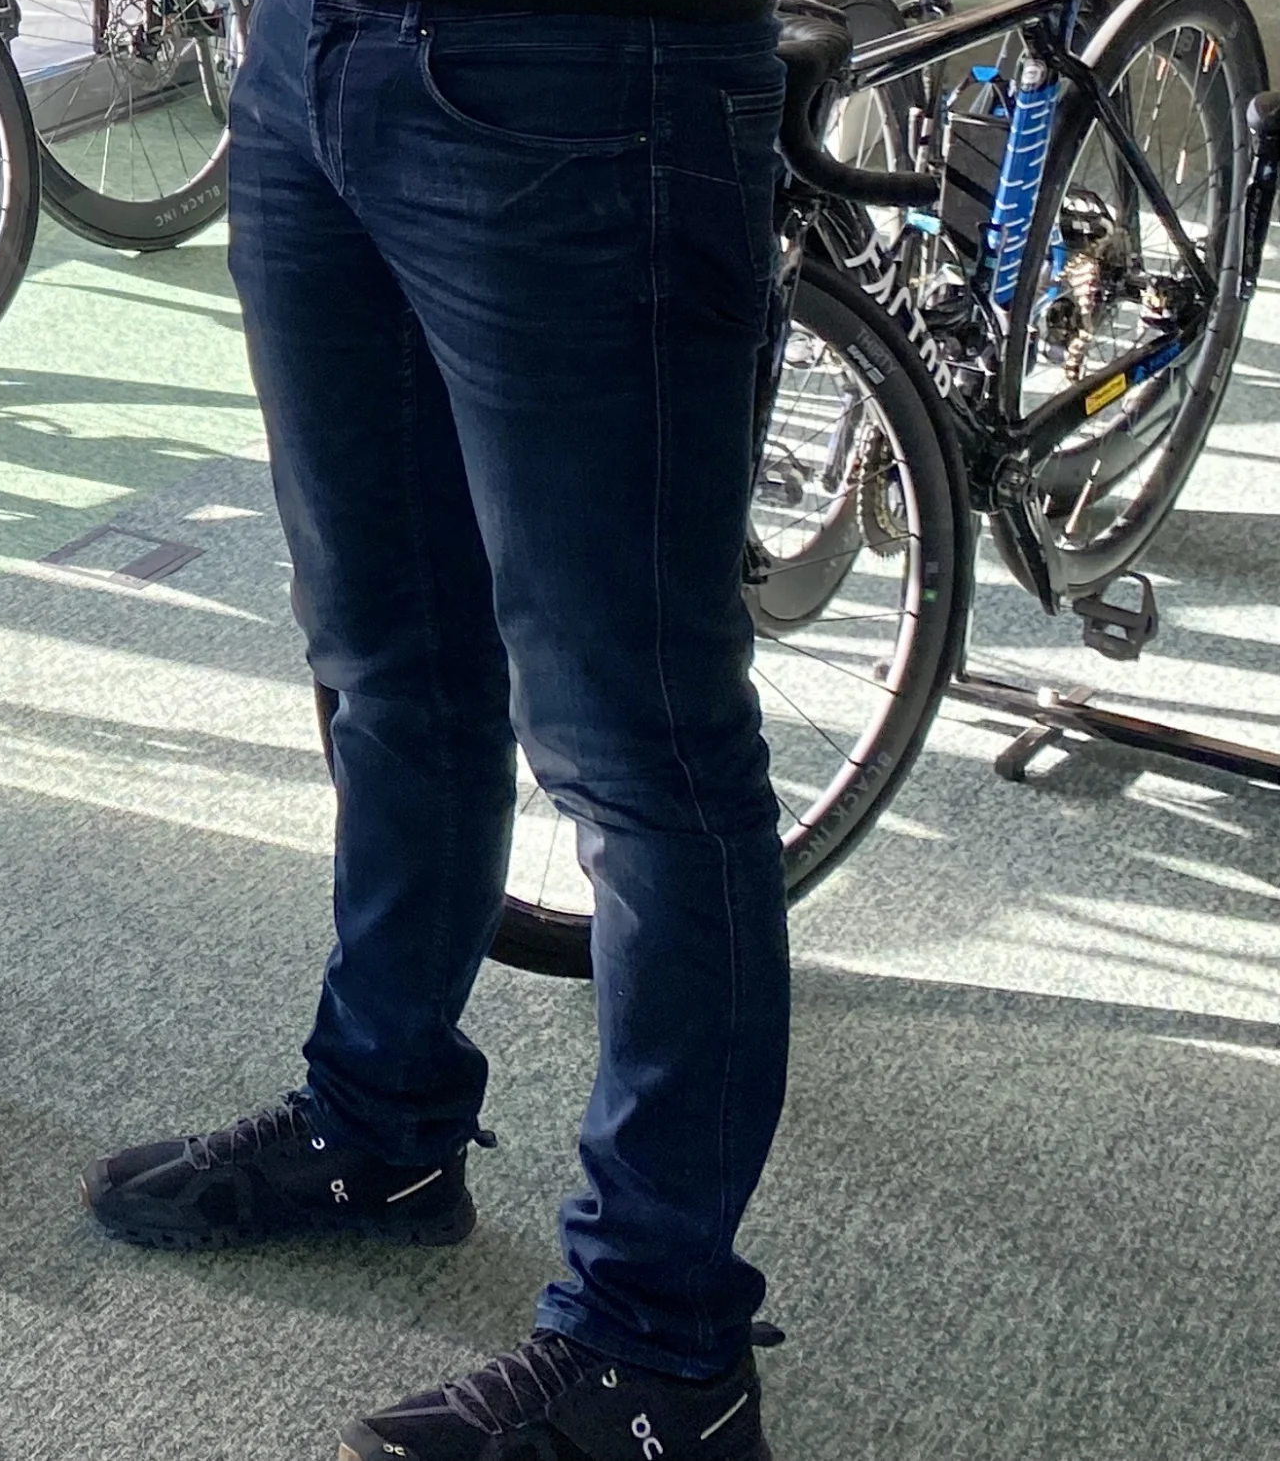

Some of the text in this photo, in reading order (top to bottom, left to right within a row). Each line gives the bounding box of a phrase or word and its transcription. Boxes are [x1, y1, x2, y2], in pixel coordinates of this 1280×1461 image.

[154, 185, 220, 227] BLACK INC
[798, 751, 893, 867] BLACK INC
